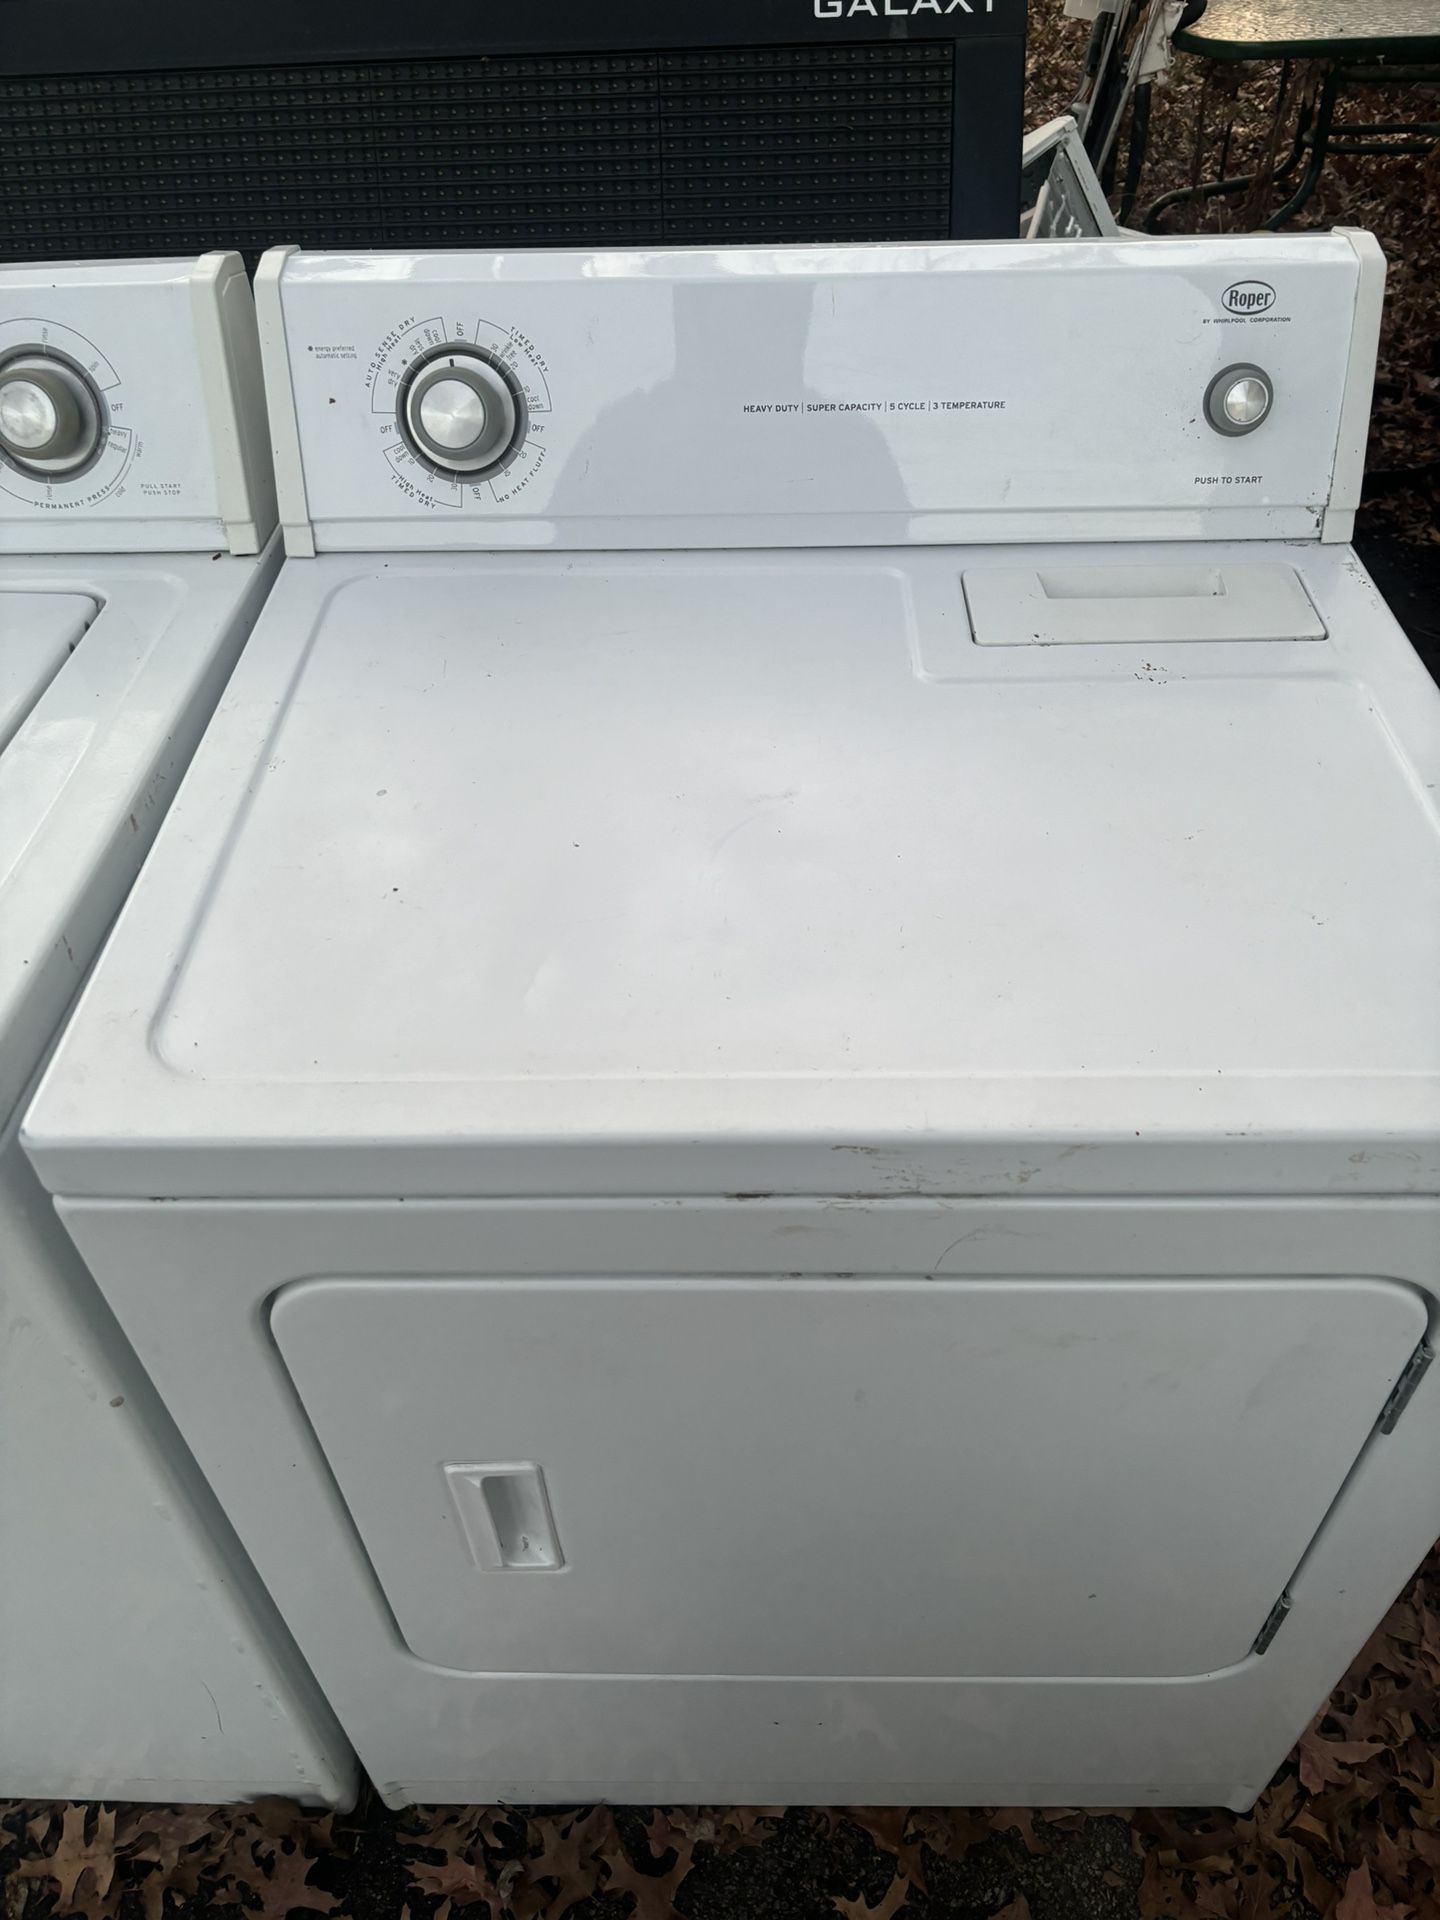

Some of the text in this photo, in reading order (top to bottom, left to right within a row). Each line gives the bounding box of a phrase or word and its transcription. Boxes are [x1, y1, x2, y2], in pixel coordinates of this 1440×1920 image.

[1228, 290, 1271, 310] Roper
[365, 316, 416, 388] AUTO SENSE DRY
[376, 335, 402, 370] High Heat
[510, 326, 548, 372] TIMED DRY
[510, 334, 538, 366] Low Heat
[110, 402, 124, 412] OFF
[743, 401, 1006, 413] HEAVY DUTY SUPER CAPACITY 5 CYCLE 3 TEMPERATURE
[380, 425, 392, 434] OFF
[532, 424, 545, 432] OFF
[500, 451, 546, 502] NO HEAT FLUFF
[1194, 476, 1218, 485] PUSH
[1235, 476, 1263, 484] START
[34, 486, 110, 509] PERMANENT PRESS
[392, 475, 436, 509] TIMED DRY
[398, 476, 433, 502] High Heat
[472, 487, 481, 500] OFF
